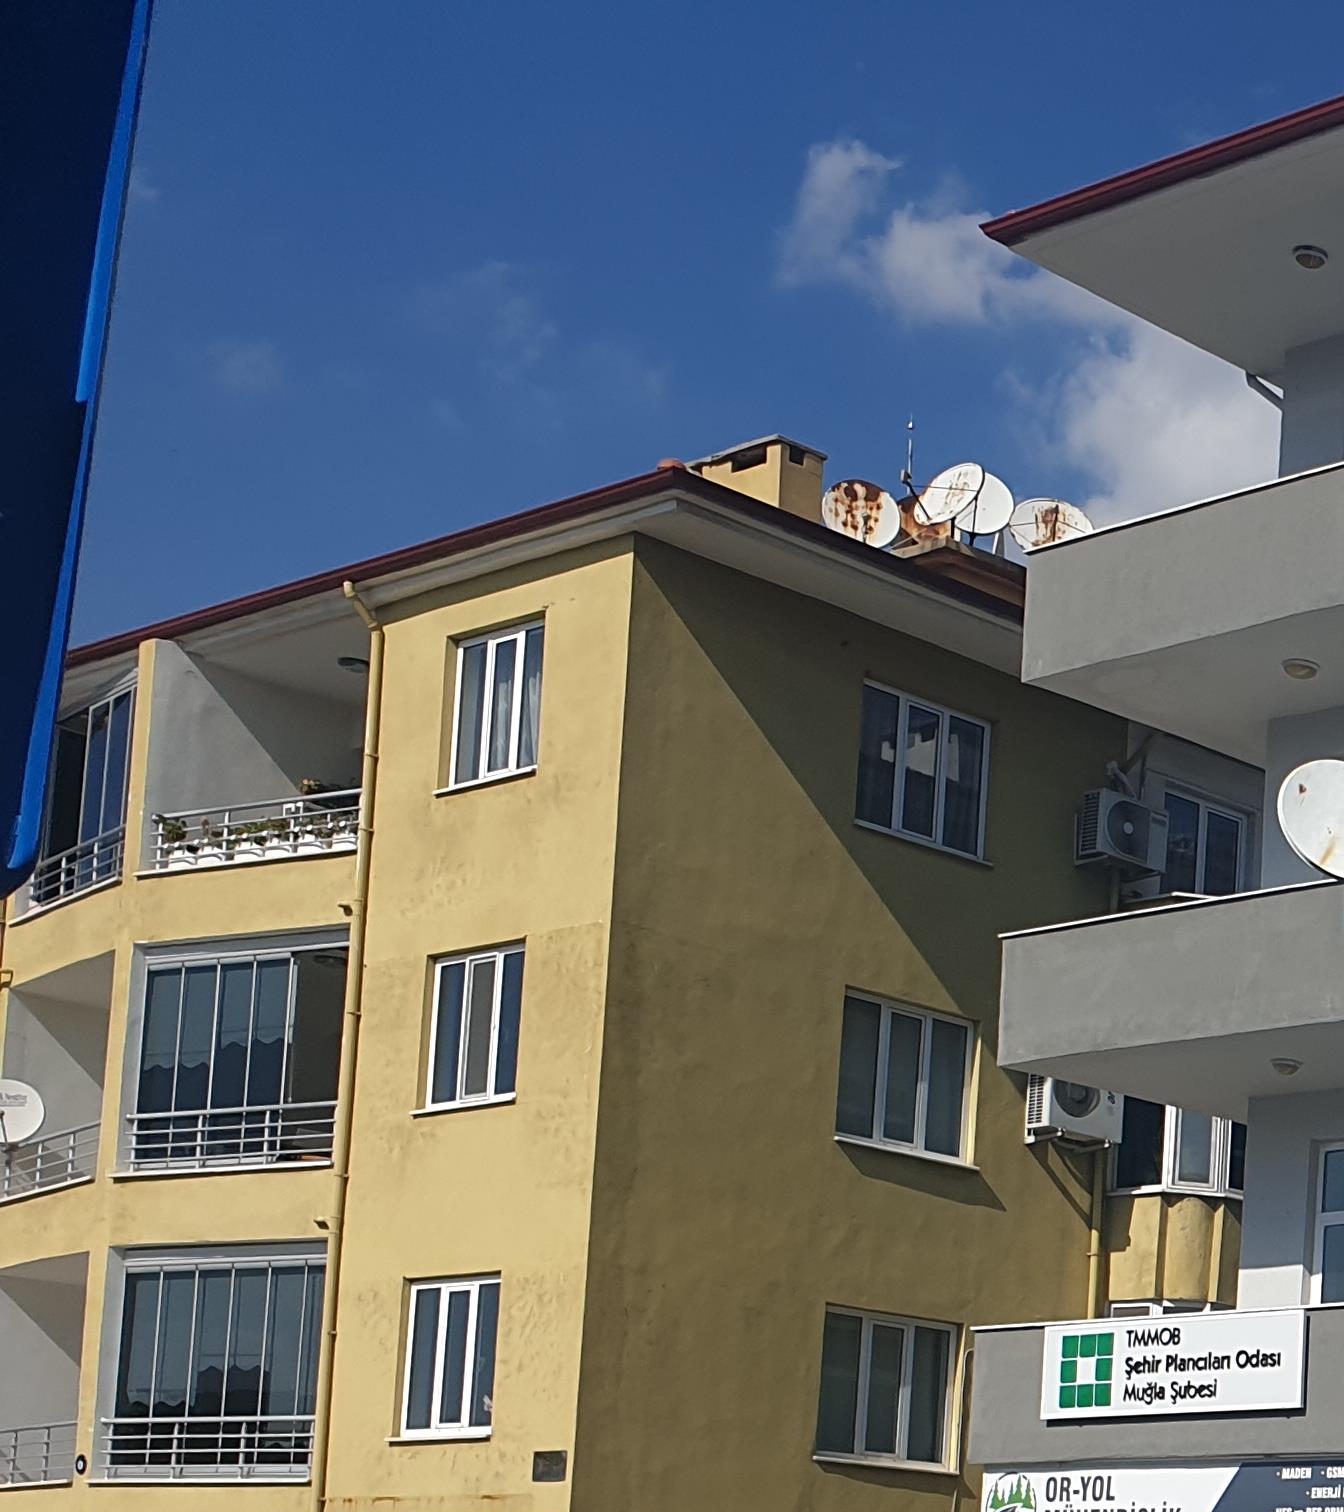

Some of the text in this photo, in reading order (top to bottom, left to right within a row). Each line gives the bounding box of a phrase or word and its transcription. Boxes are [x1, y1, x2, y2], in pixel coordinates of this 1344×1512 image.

[1126, 1328, 1181, 1348] TMMOB
[1125, 1349, 1281, 1380] Şehir Plancıları Odası
[1123, 1378, 1218, 1405] Muğla Şubesi
[1281, 1468, 1312, 1480] MADEN
[1326, 1467, 1344, 1479] GSM
[1045, 1475, 1116, 1502] OR-YOL
[1311, 1484, 1341, 1499] ENERJİ
